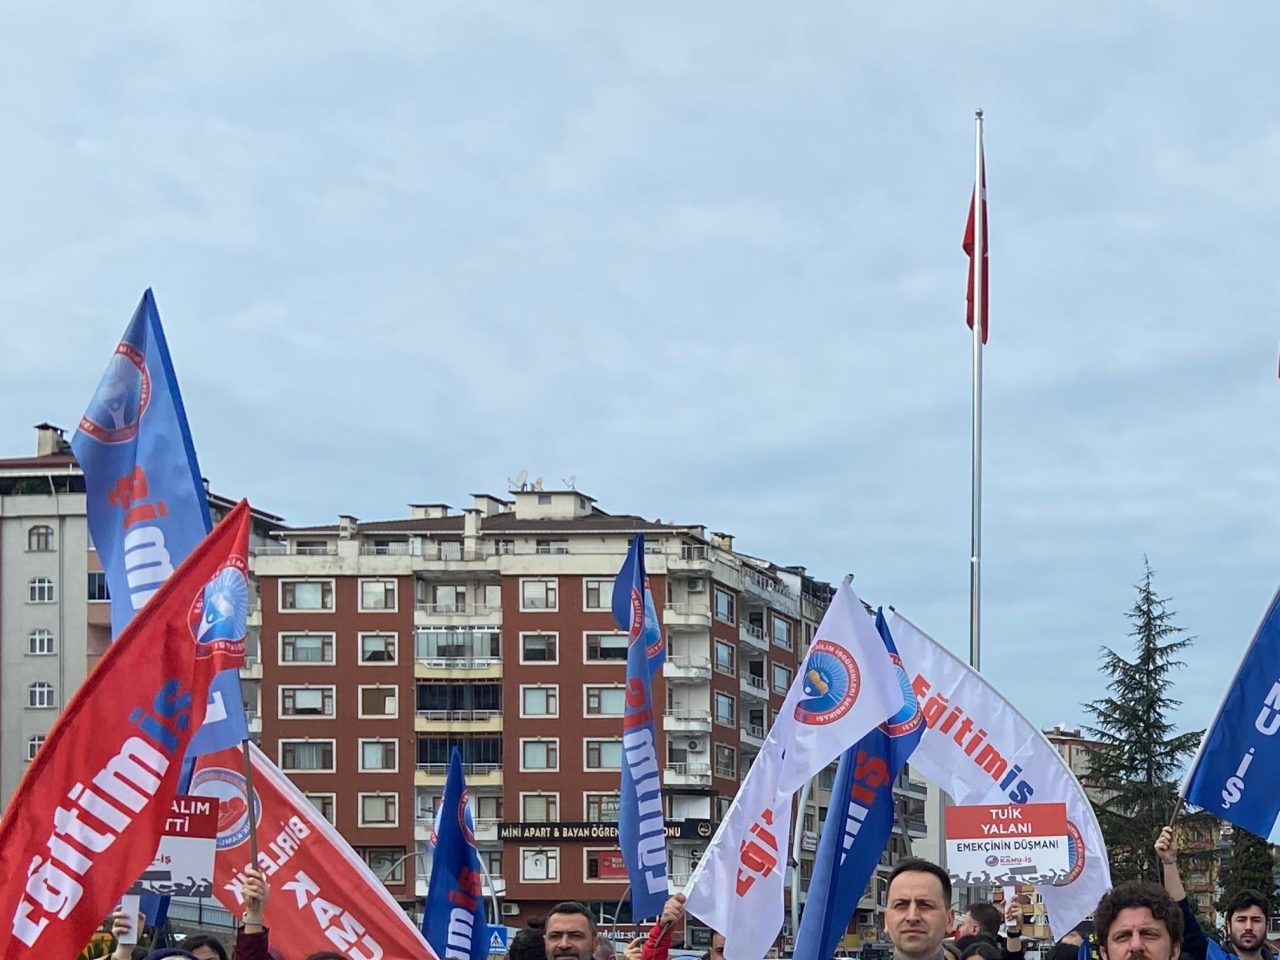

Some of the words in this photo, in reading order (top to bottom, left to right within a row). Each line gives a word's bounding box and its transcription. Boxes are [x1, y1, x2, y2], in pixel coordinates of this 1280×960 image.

[911, 673, 1035, 805] Eğitimiş
[1221, 746, 1256, 809] İŞ
[11, 678, 194, 949] Eğitimiş
[171, 801, 210, 815] ALIM
[989, 806, 1022, 819] TUİK
[501, 825, 522, 838] MİNİ
[524, 827, 550, 838] APART
[554, 828, 560, 838] &
[563, 827, 590, 838] BAYAN
[591, 824, 620, 838] ÖĞREN
[981, 823, 1032, 835] YALANI
[957, 841, 1011, 852] EMEKÇİNİN
[1014, 839, 1059, 851] DÜŞMANI
